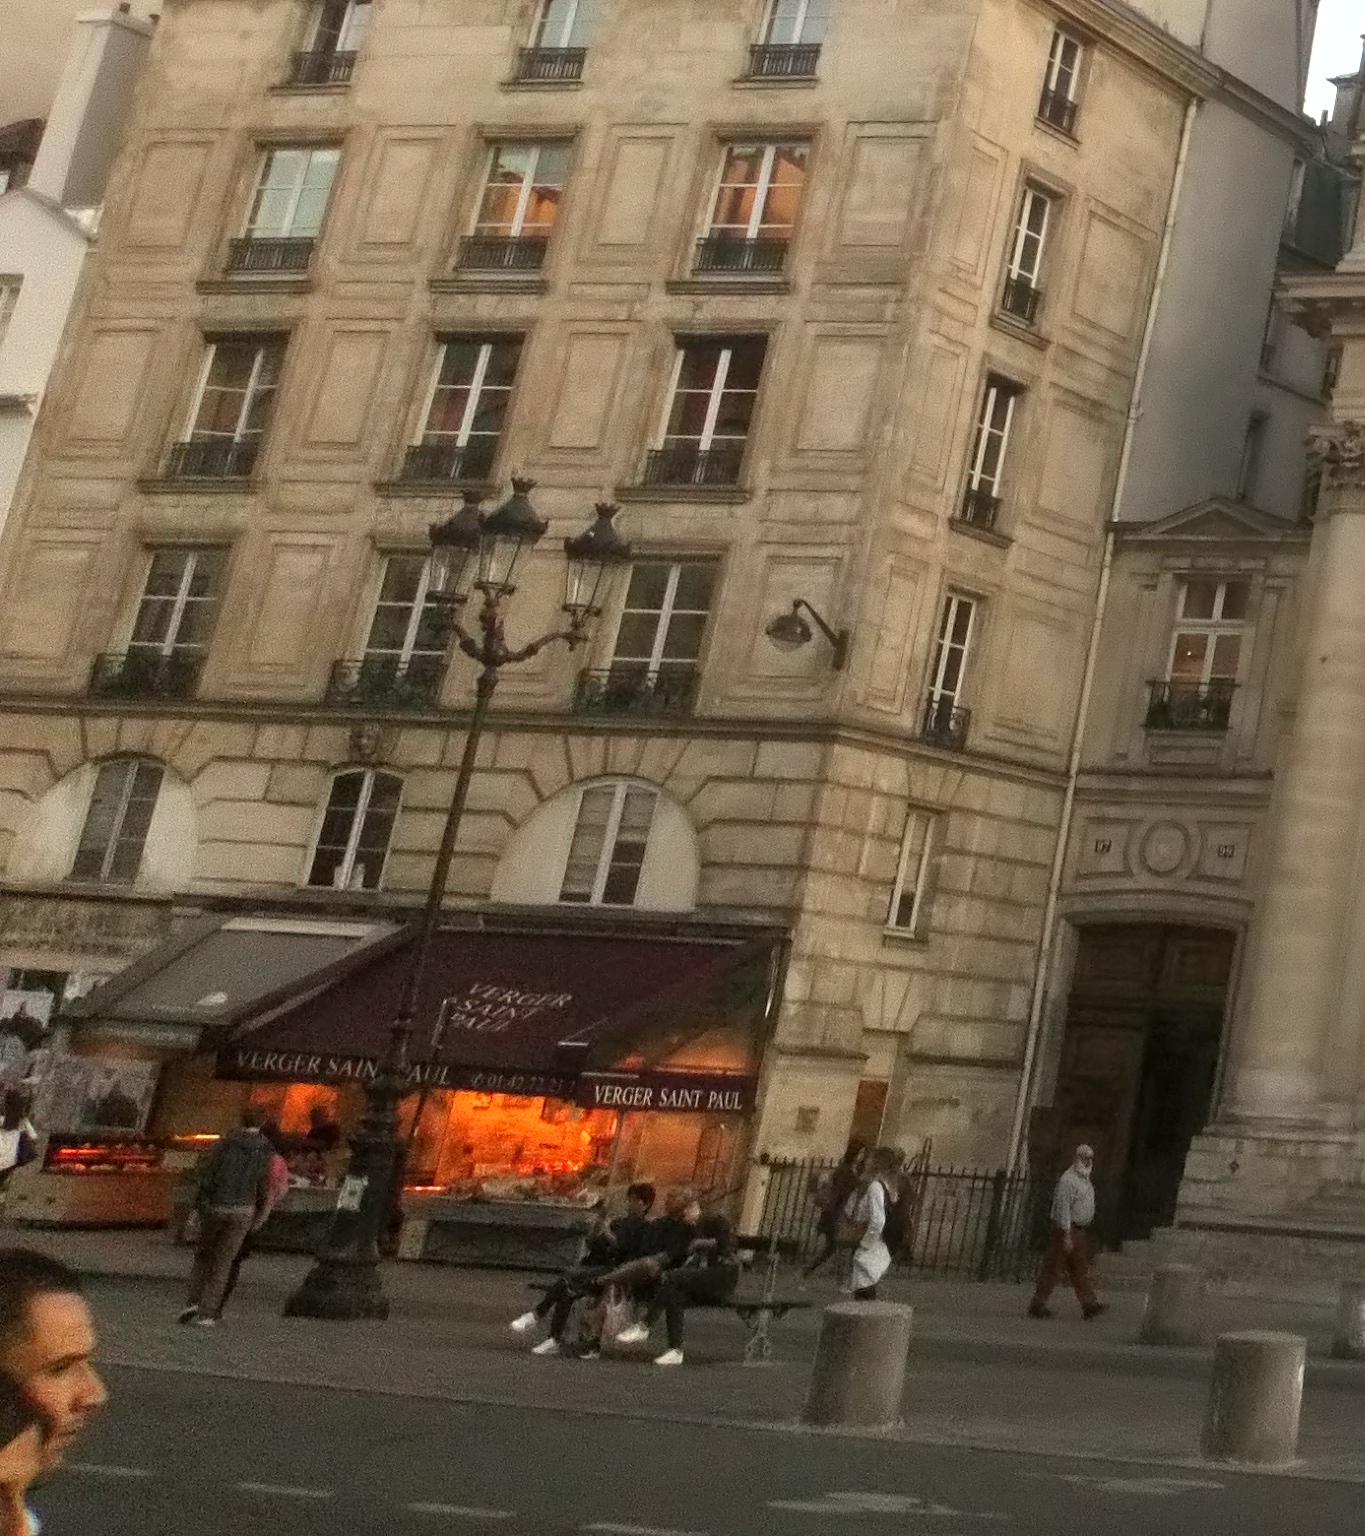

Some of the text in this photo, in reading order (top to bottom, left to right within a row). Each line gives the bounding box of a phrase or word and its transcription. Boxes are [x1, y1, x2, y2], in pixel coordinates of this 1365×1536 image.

[469, 983, 573, 1007] VERGER
[464, 999, 544, 1020] SAINT
[237, 1050, 321, 1075] VERGER
[325, 1057, 381, 1079] SAIN
[594, 1084, 652, 1107] VERGER
[658, 1087, 703, 1109] SAINT
[707, 1090, 743, 1111] PAUL
